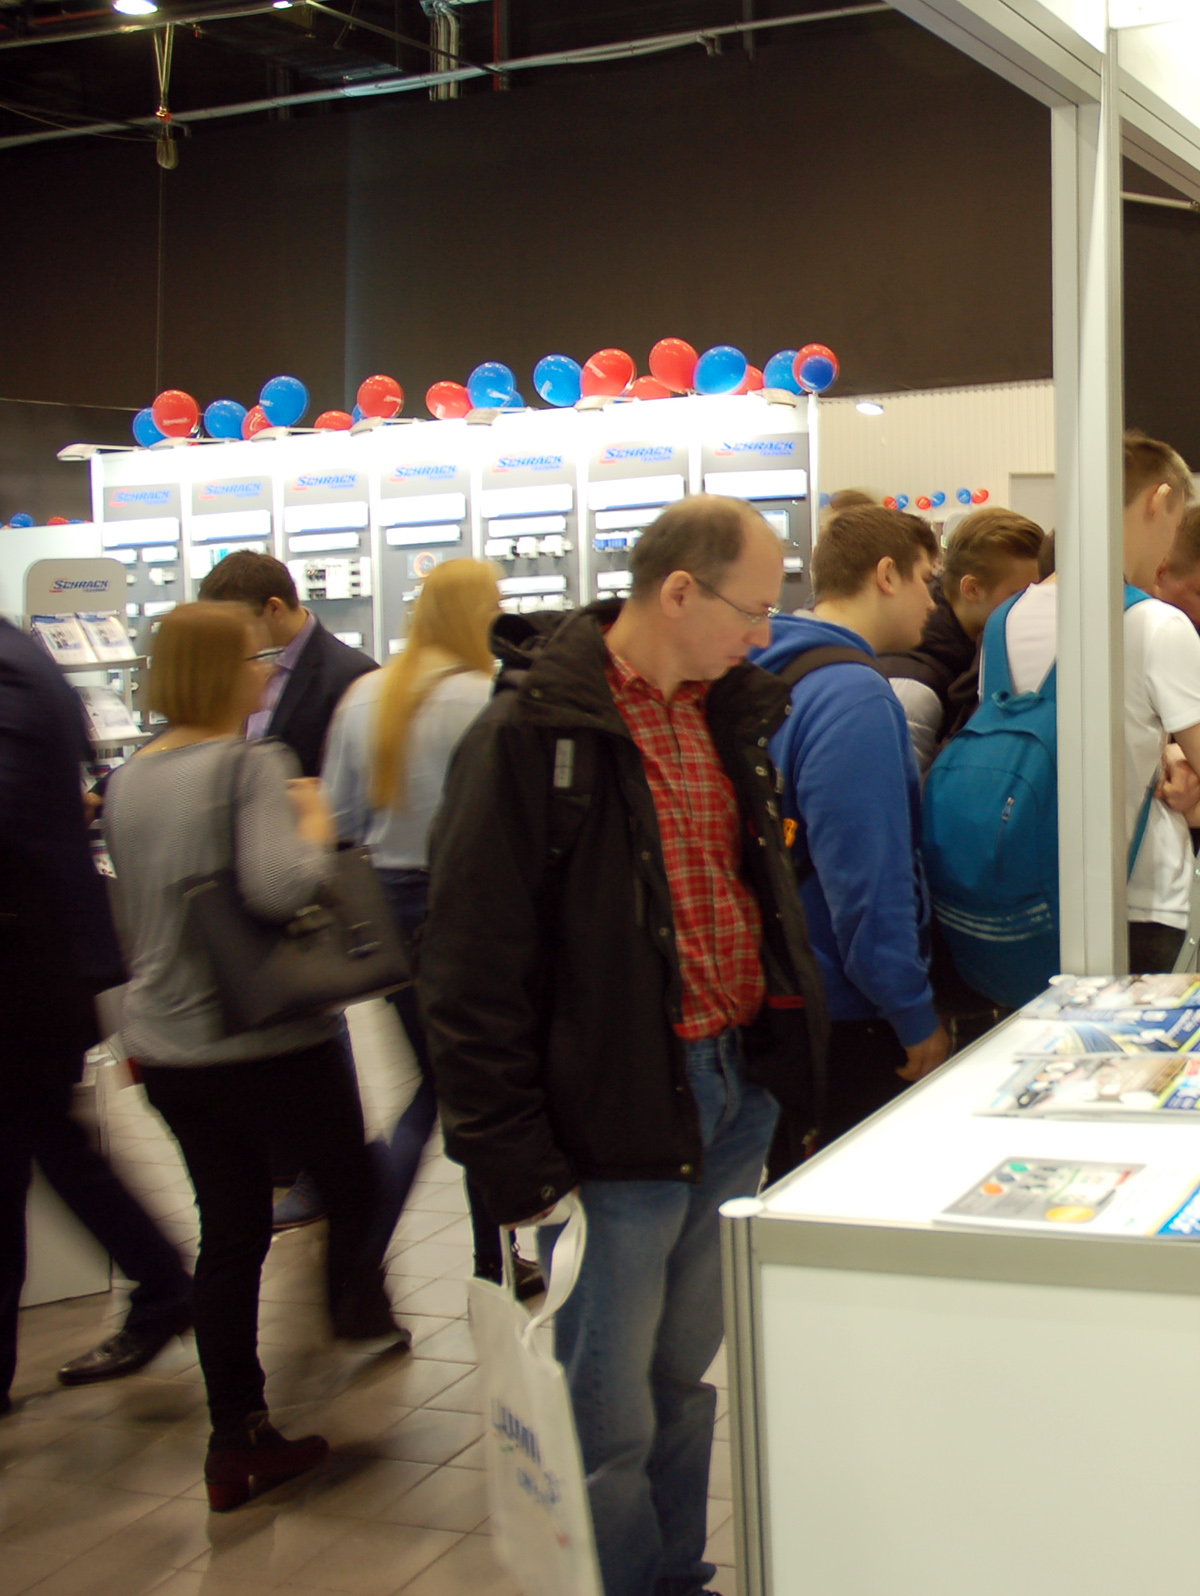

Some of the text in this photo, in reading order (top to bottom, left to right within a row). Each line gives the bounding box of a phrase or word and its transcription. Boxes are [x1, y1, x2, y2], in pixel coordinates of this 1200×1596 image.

[604, 446, 673, 460] SCHRACK
[498, 455, 562, 469] SCHRACK
[297, 474, 356, 488] SCHRACK
[53, 579, 109, 590] SCHRACK
